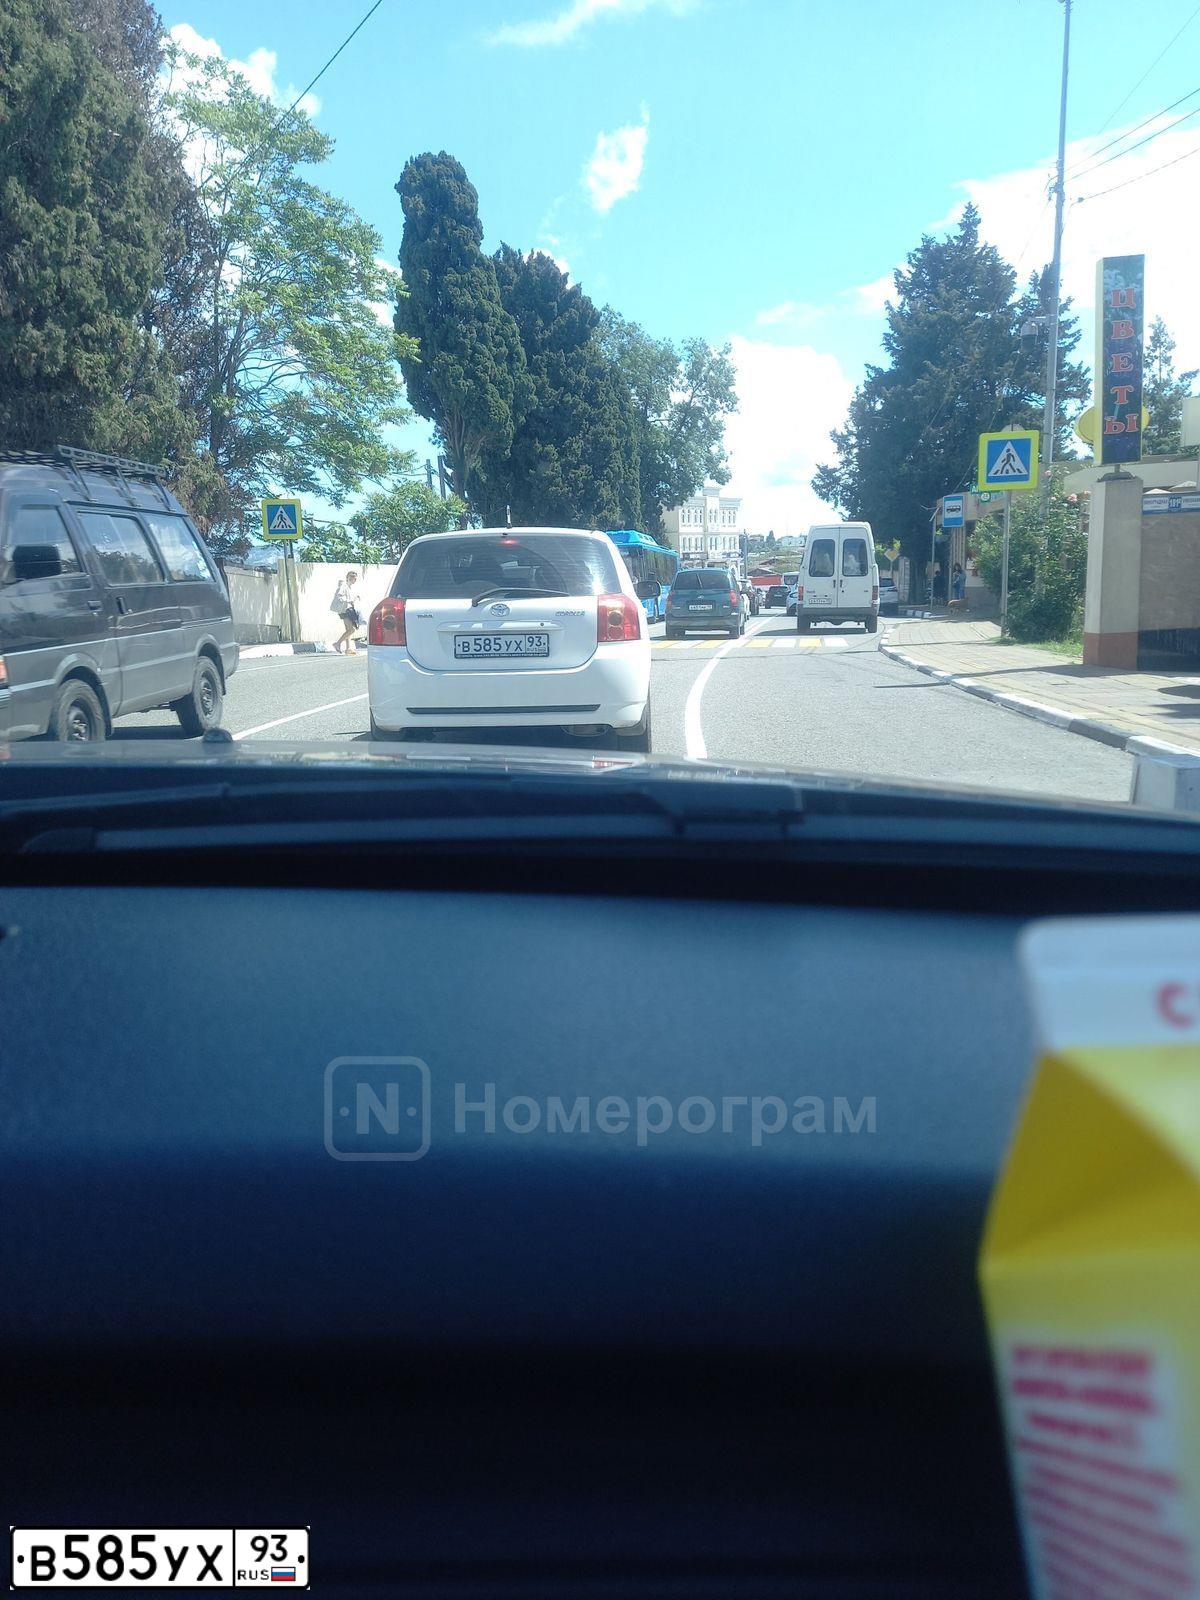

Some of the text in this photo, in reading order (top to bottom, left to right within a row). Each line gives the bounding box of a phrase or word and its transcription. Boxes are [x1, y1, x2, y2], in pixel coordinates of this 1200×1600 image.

[1104, 287, 1139, 435] ЦВЕТЫ
[462, 636, 542, 652] В585УХ 93
